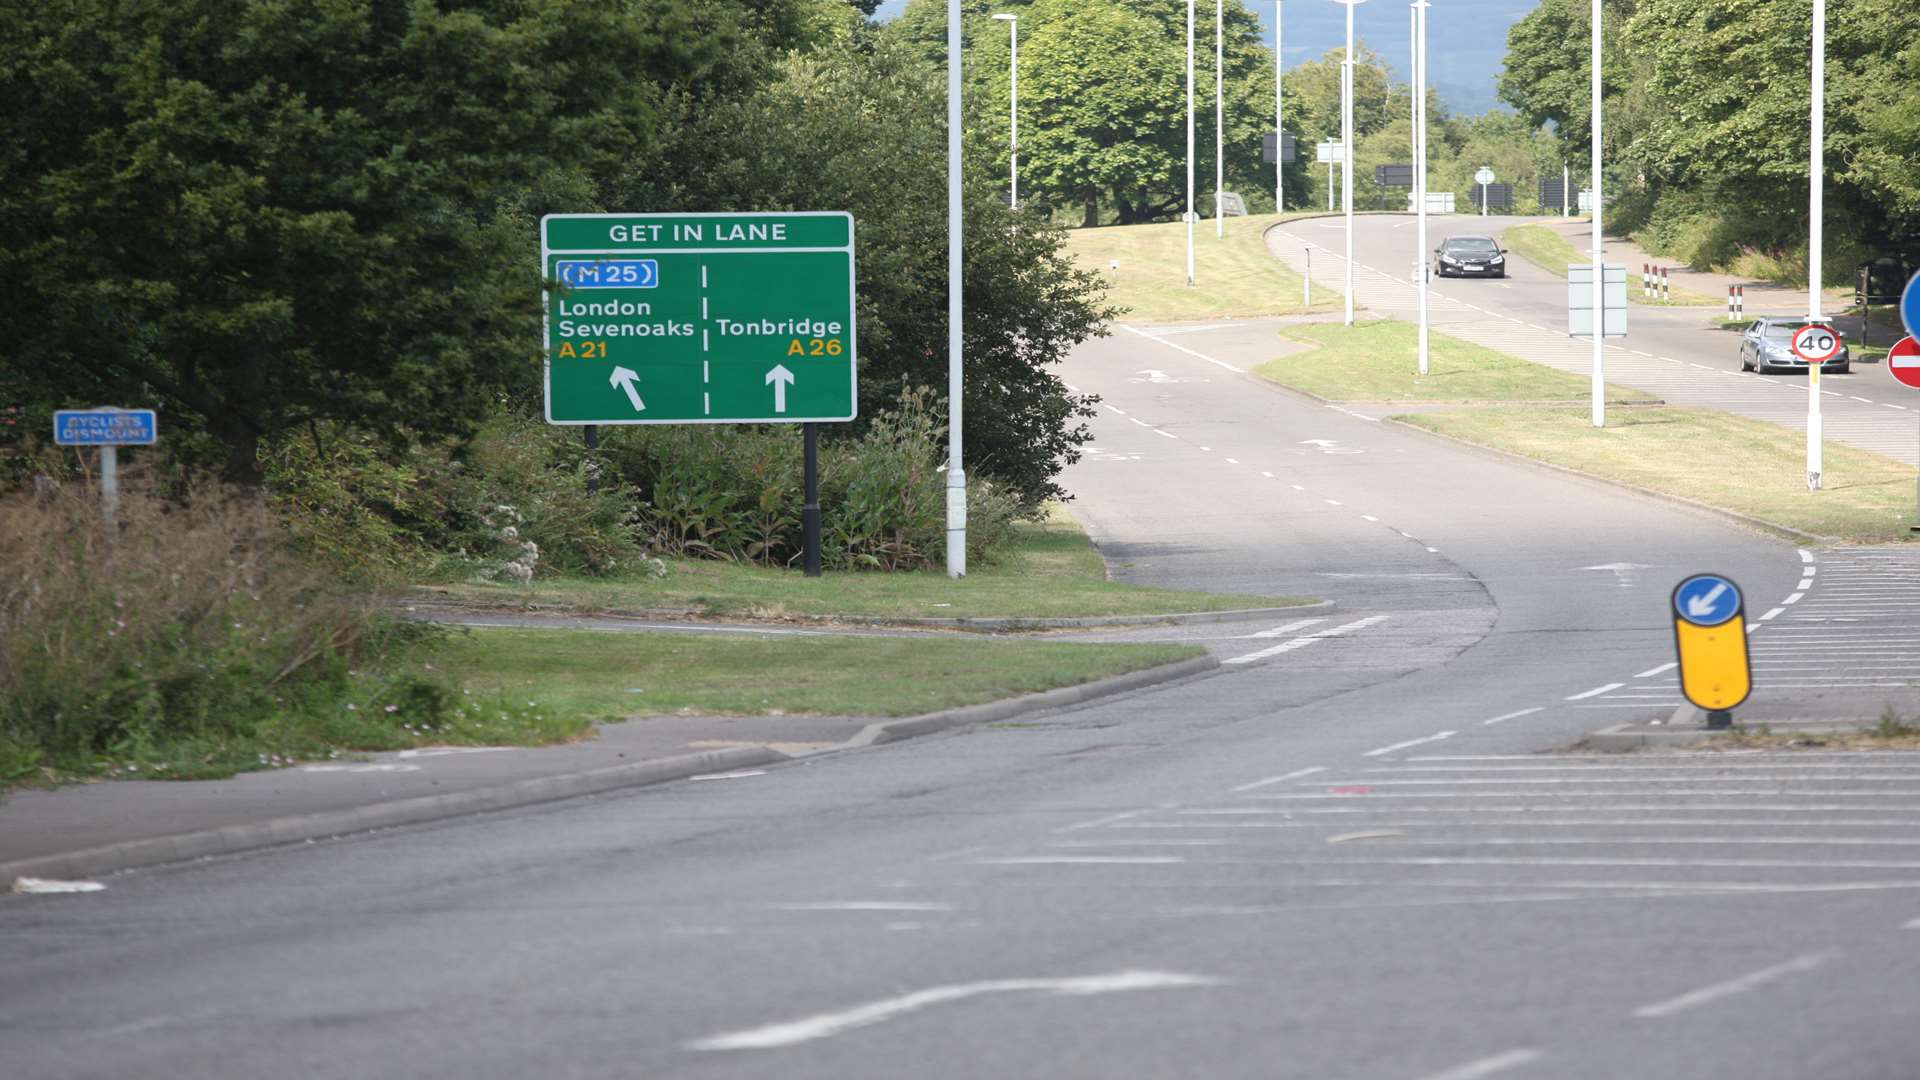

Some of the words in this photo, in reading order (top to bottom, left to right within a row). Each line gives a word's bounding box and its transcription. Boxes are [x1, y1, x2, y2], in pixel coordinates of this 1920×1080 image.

[609, 225, 663, 242] GET
[674, 224, 703, 241] IN
[715, 224, 787, 241] LANE
[560, 299, 651, 316] London
[559, 320, 694, 337] Sevenoaks
[715, 318, 842, 338] Tonbridge
[1799, 335, 1834, 351] 40
